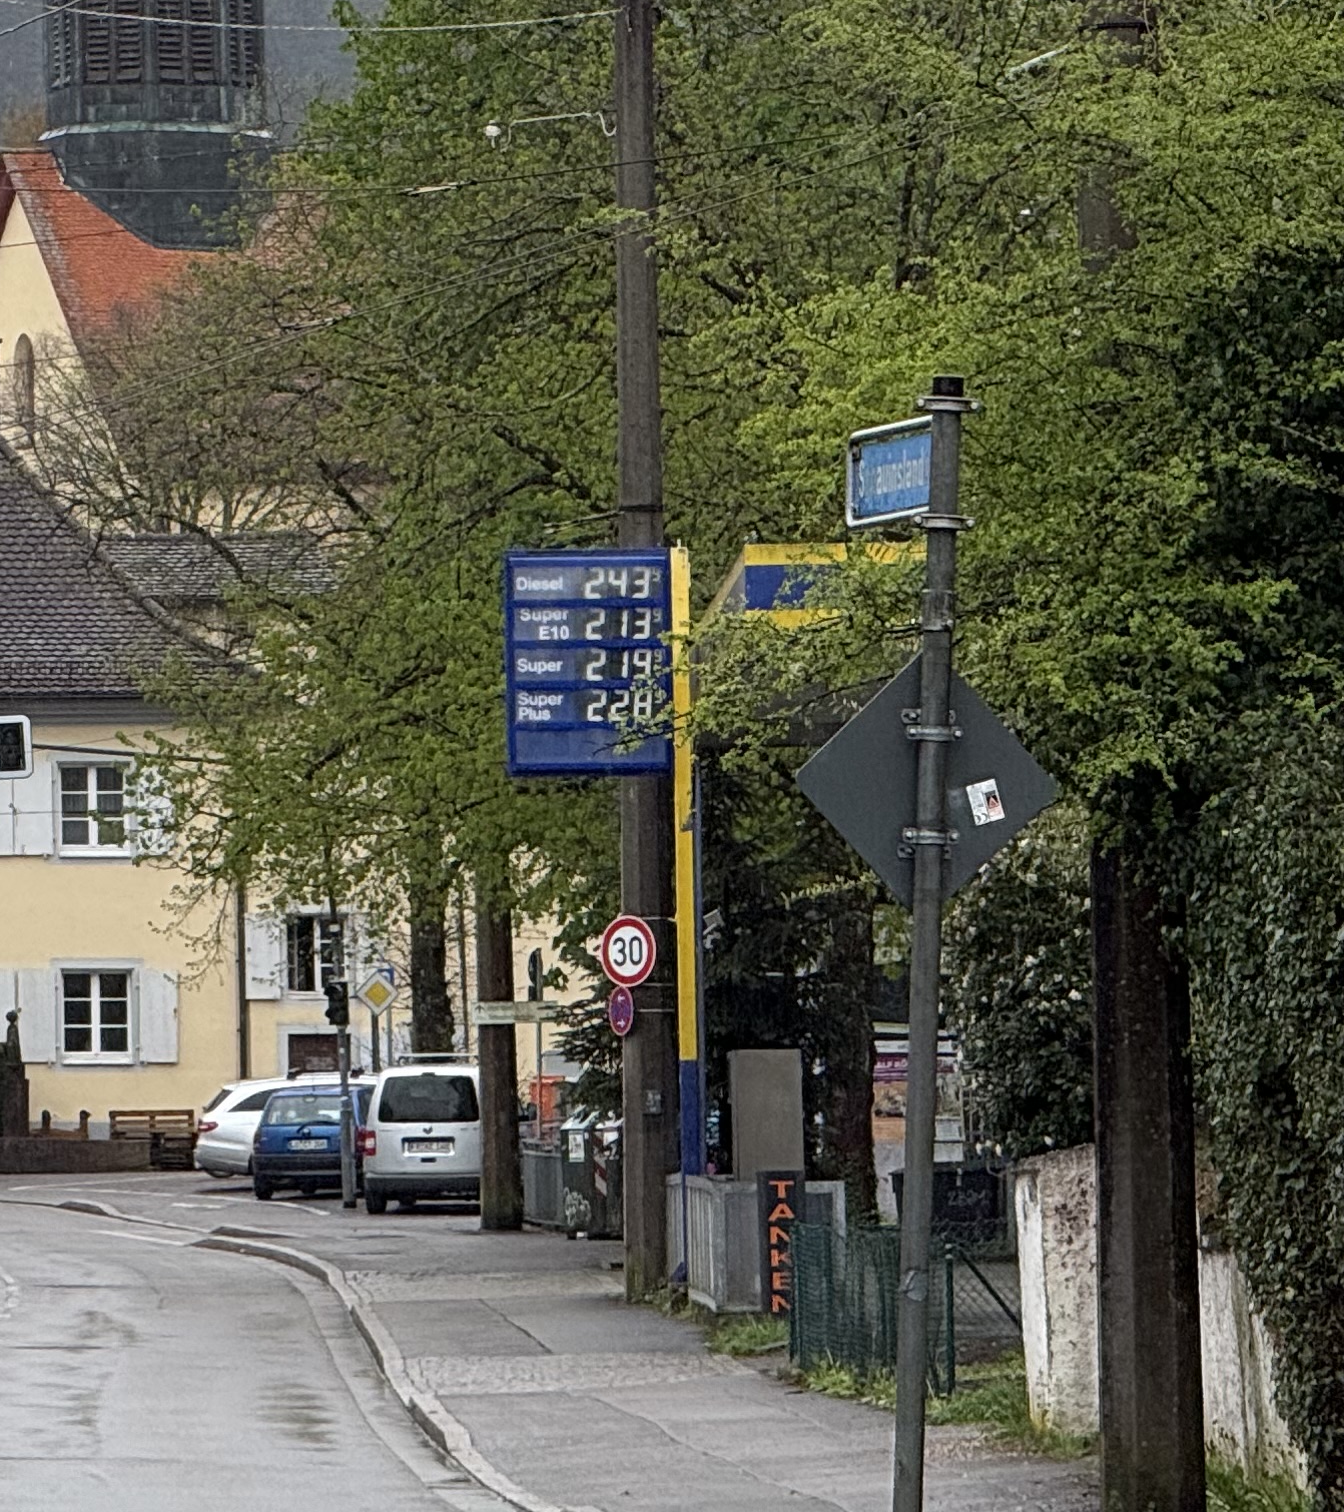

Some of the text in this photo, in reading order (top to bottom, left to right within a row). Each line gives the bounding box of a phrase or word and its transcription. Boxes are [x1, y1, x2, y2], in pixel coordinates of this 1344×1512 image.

[516, 576, 563, 591] Diesel
[520, 607, 569, 624] Super
[539, 625, 570, 640] E10
[517, 658, 564, 675] Super
[518, 692, 564, 708] Super
[518, 707, 551, 721] Plus
[613, 935, 643, 967] 30
[768, 1180, 795, 1313] TANKEN
